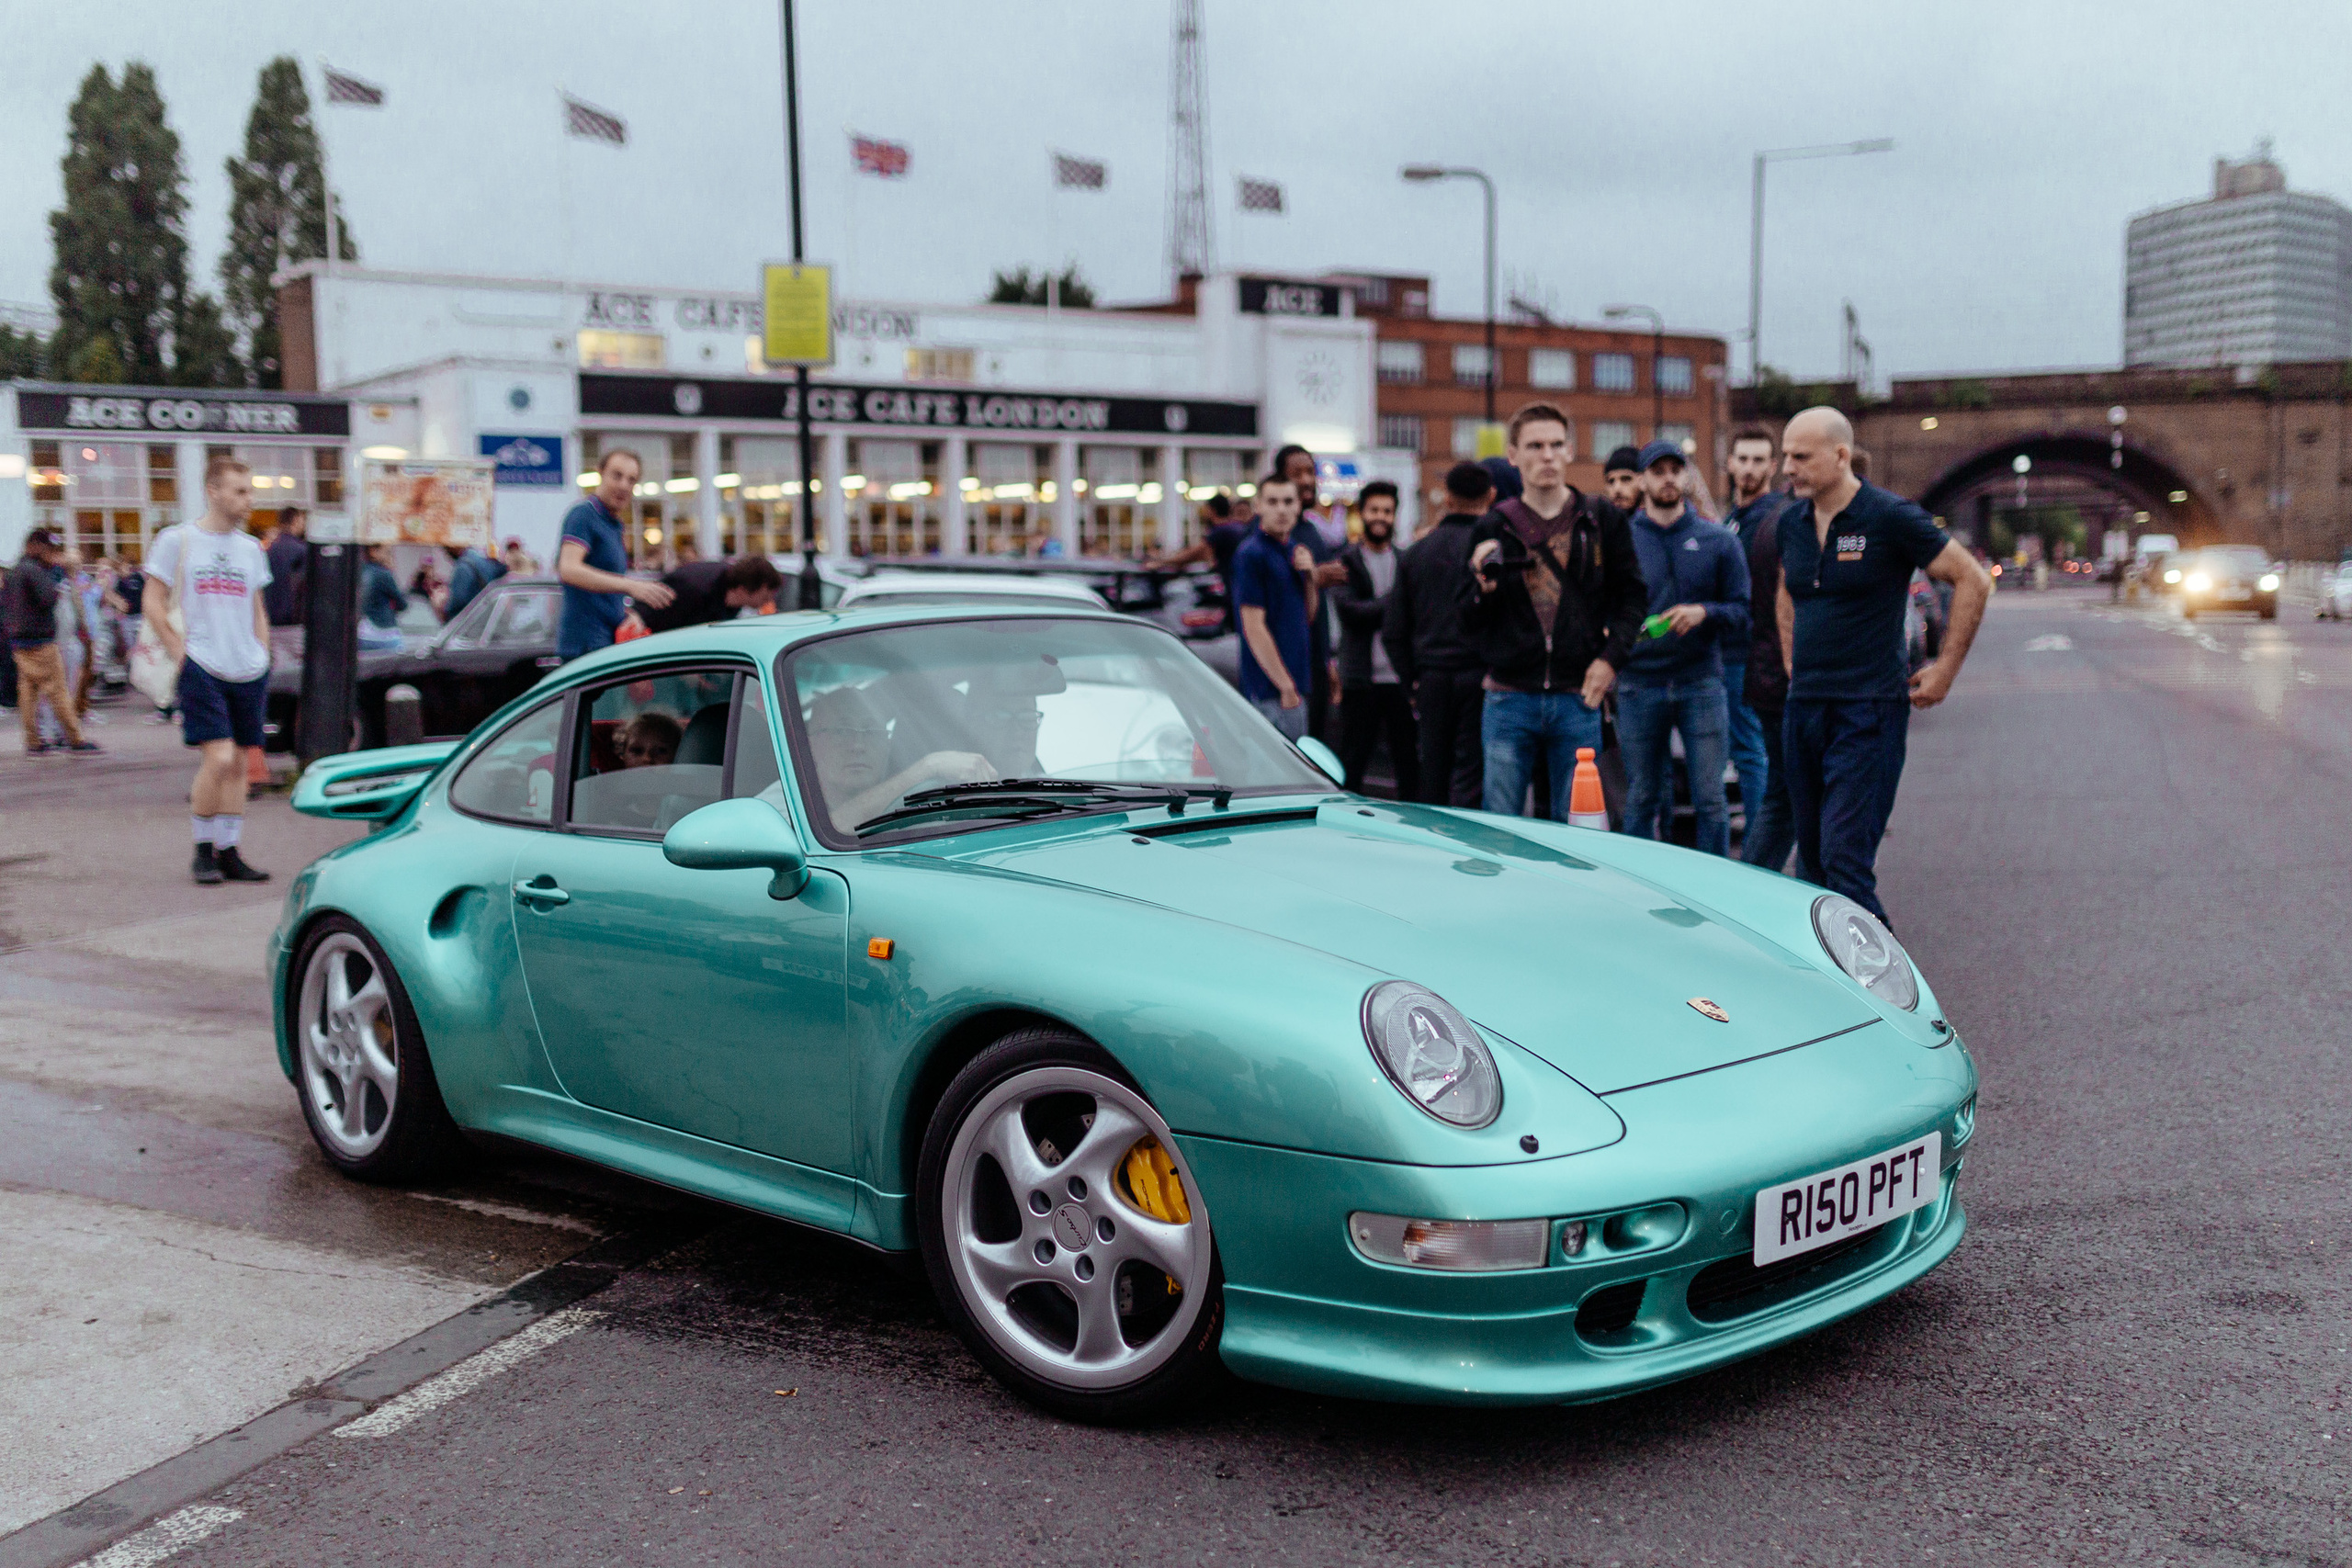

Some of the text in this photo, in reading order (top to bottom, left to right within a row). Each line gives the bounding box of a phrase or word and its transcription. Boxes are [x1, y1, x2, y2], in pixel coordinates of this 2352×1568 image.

[583, 290, 656, 327] ACE
[674, 298, 763, 333] CAFE
[831, 306, 919, 339] NDON
[1263, 284, 1323, 313] ACE
[66, 395, 145, 429] ACE
[783, 387, 1109, 429] ACE CAFE LONDON
[1140, 1179, 1153, 1214] PORSC
[1781, 1145, 1925, 1246] R150 PFT
[1057, 1209, 1087, 1247] turbo S
